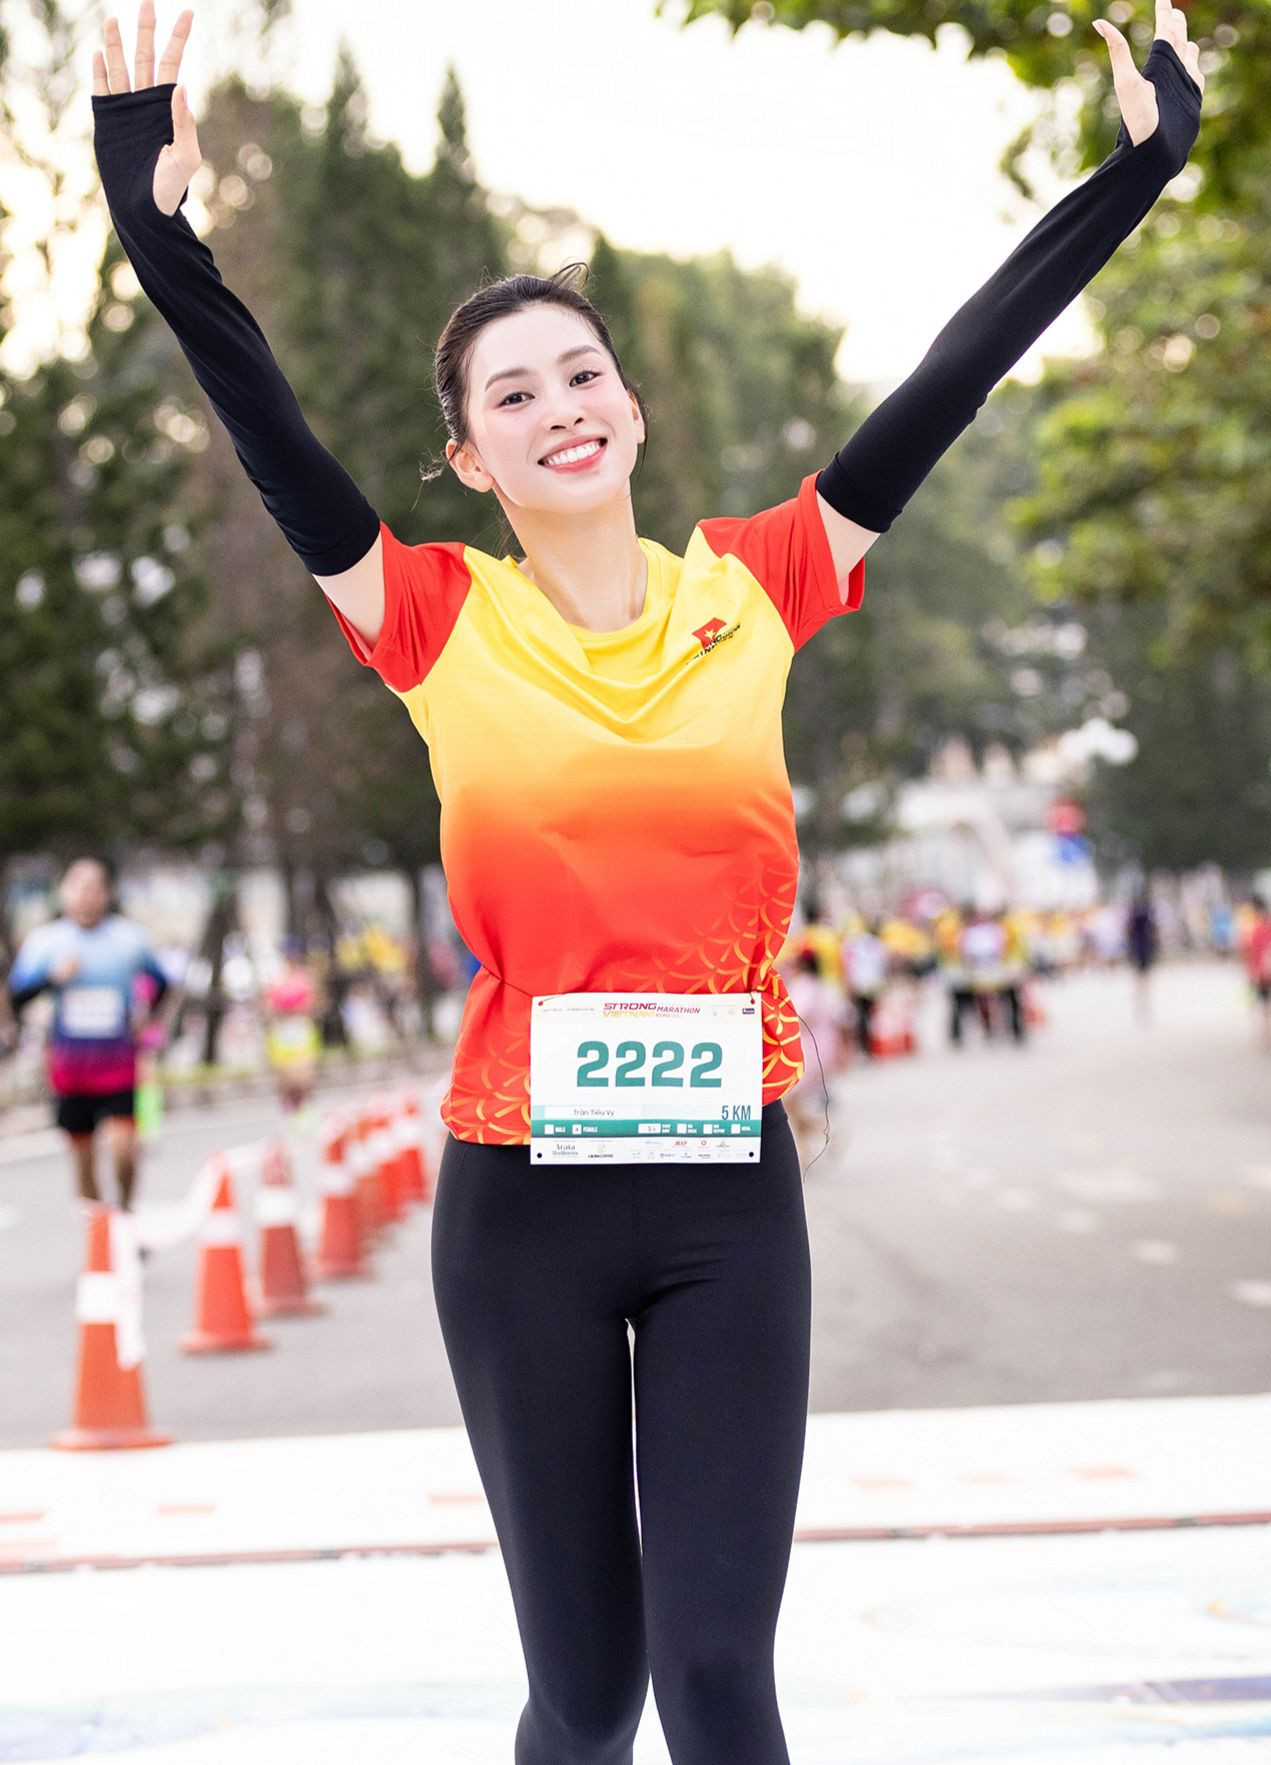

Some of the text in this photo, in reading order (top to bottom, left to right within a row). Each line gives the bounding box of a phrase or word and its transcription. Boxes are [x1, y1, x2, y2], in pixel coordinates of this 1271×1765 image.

[603, 1003, 657, 1011] STRONG
[656, 1006, 700, 1014] MARATHON
[603, 1010, 656, 1018] VIETNAM
[576, 1040, 723, 1088] 2222
[721, 1104, 729, 1121] 5
[732, 1104, 751, 1121] KM
